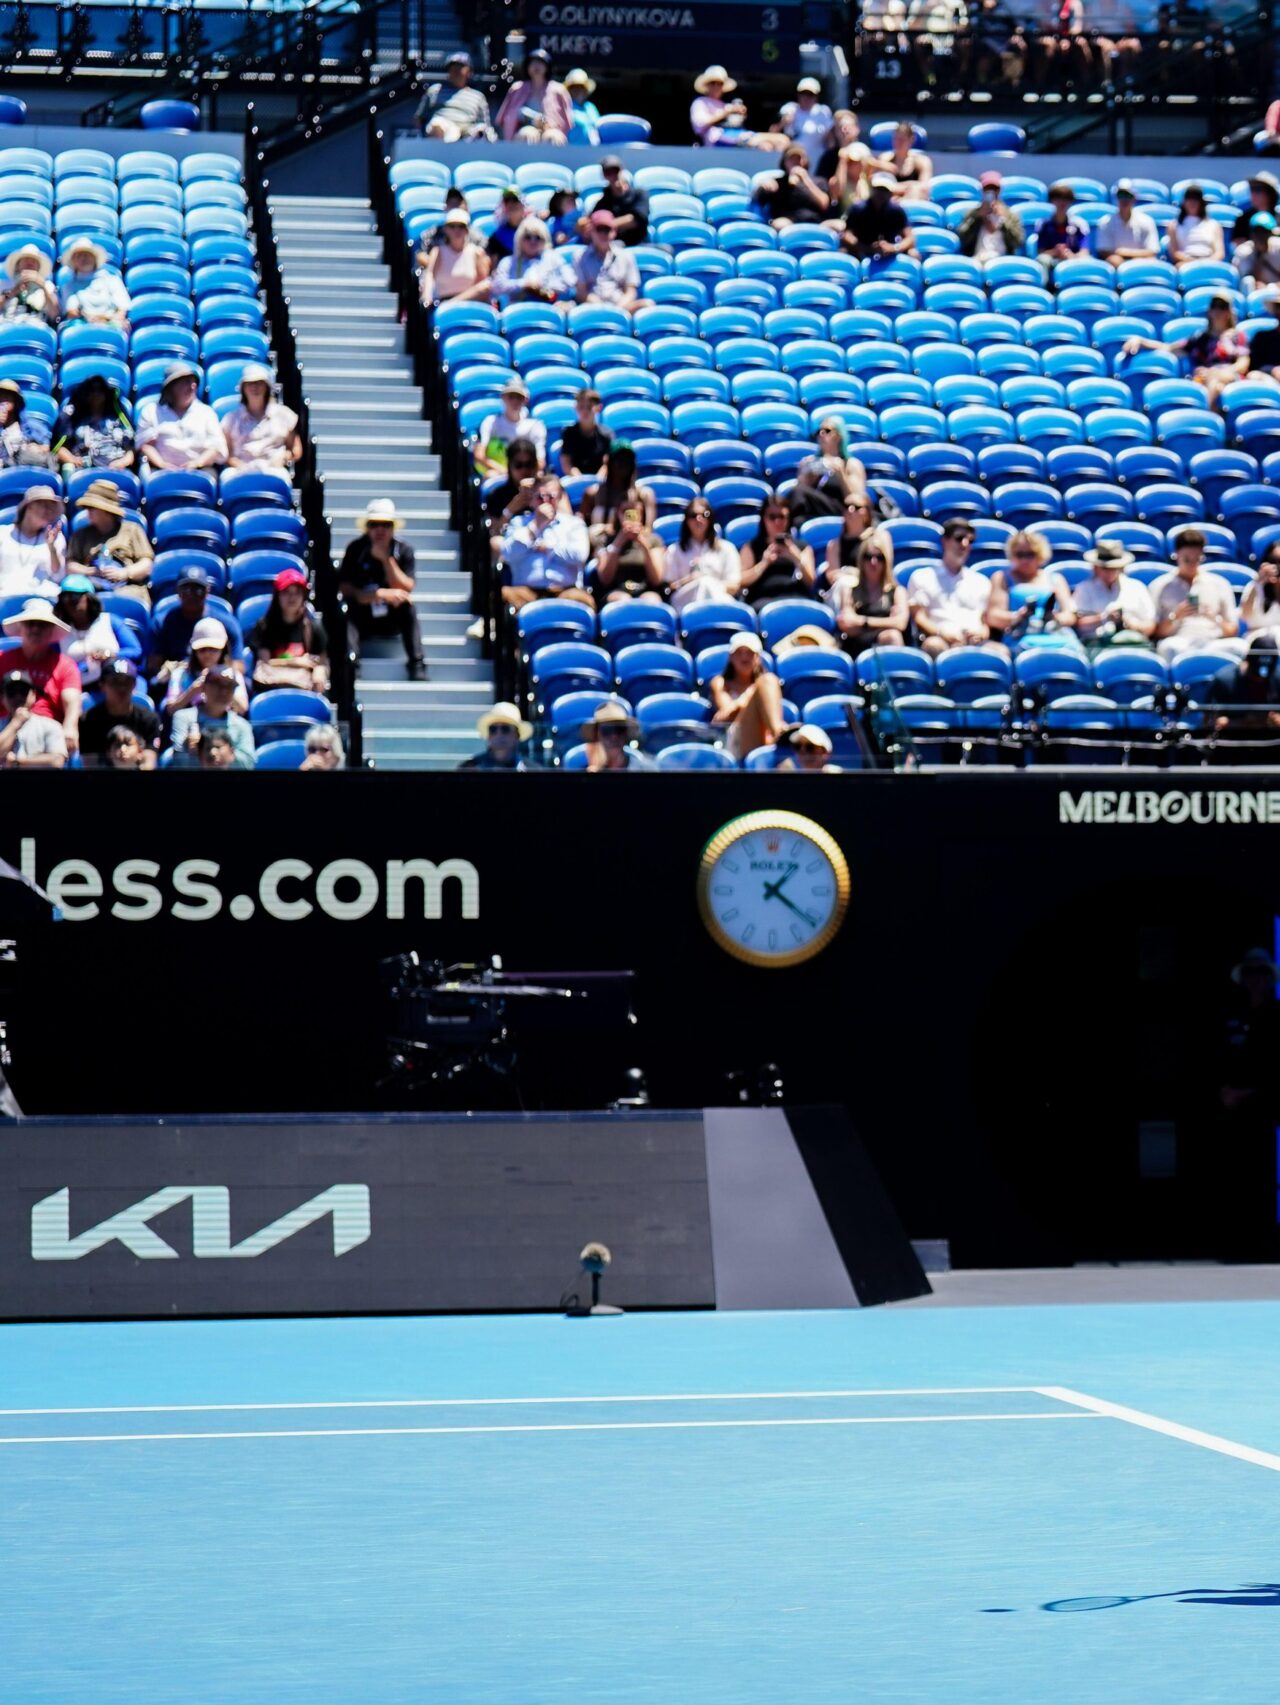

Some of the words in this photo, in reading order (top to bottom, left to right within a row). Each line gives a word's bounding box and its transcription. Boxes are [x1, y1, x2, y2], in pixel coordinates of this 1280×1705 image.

[761, 7, 779, 31] 3
[539, 34, 614, 55] M.KEYS
[876, 59, 901, 79] 13
[31, 1183, 372, 1260] KIA
